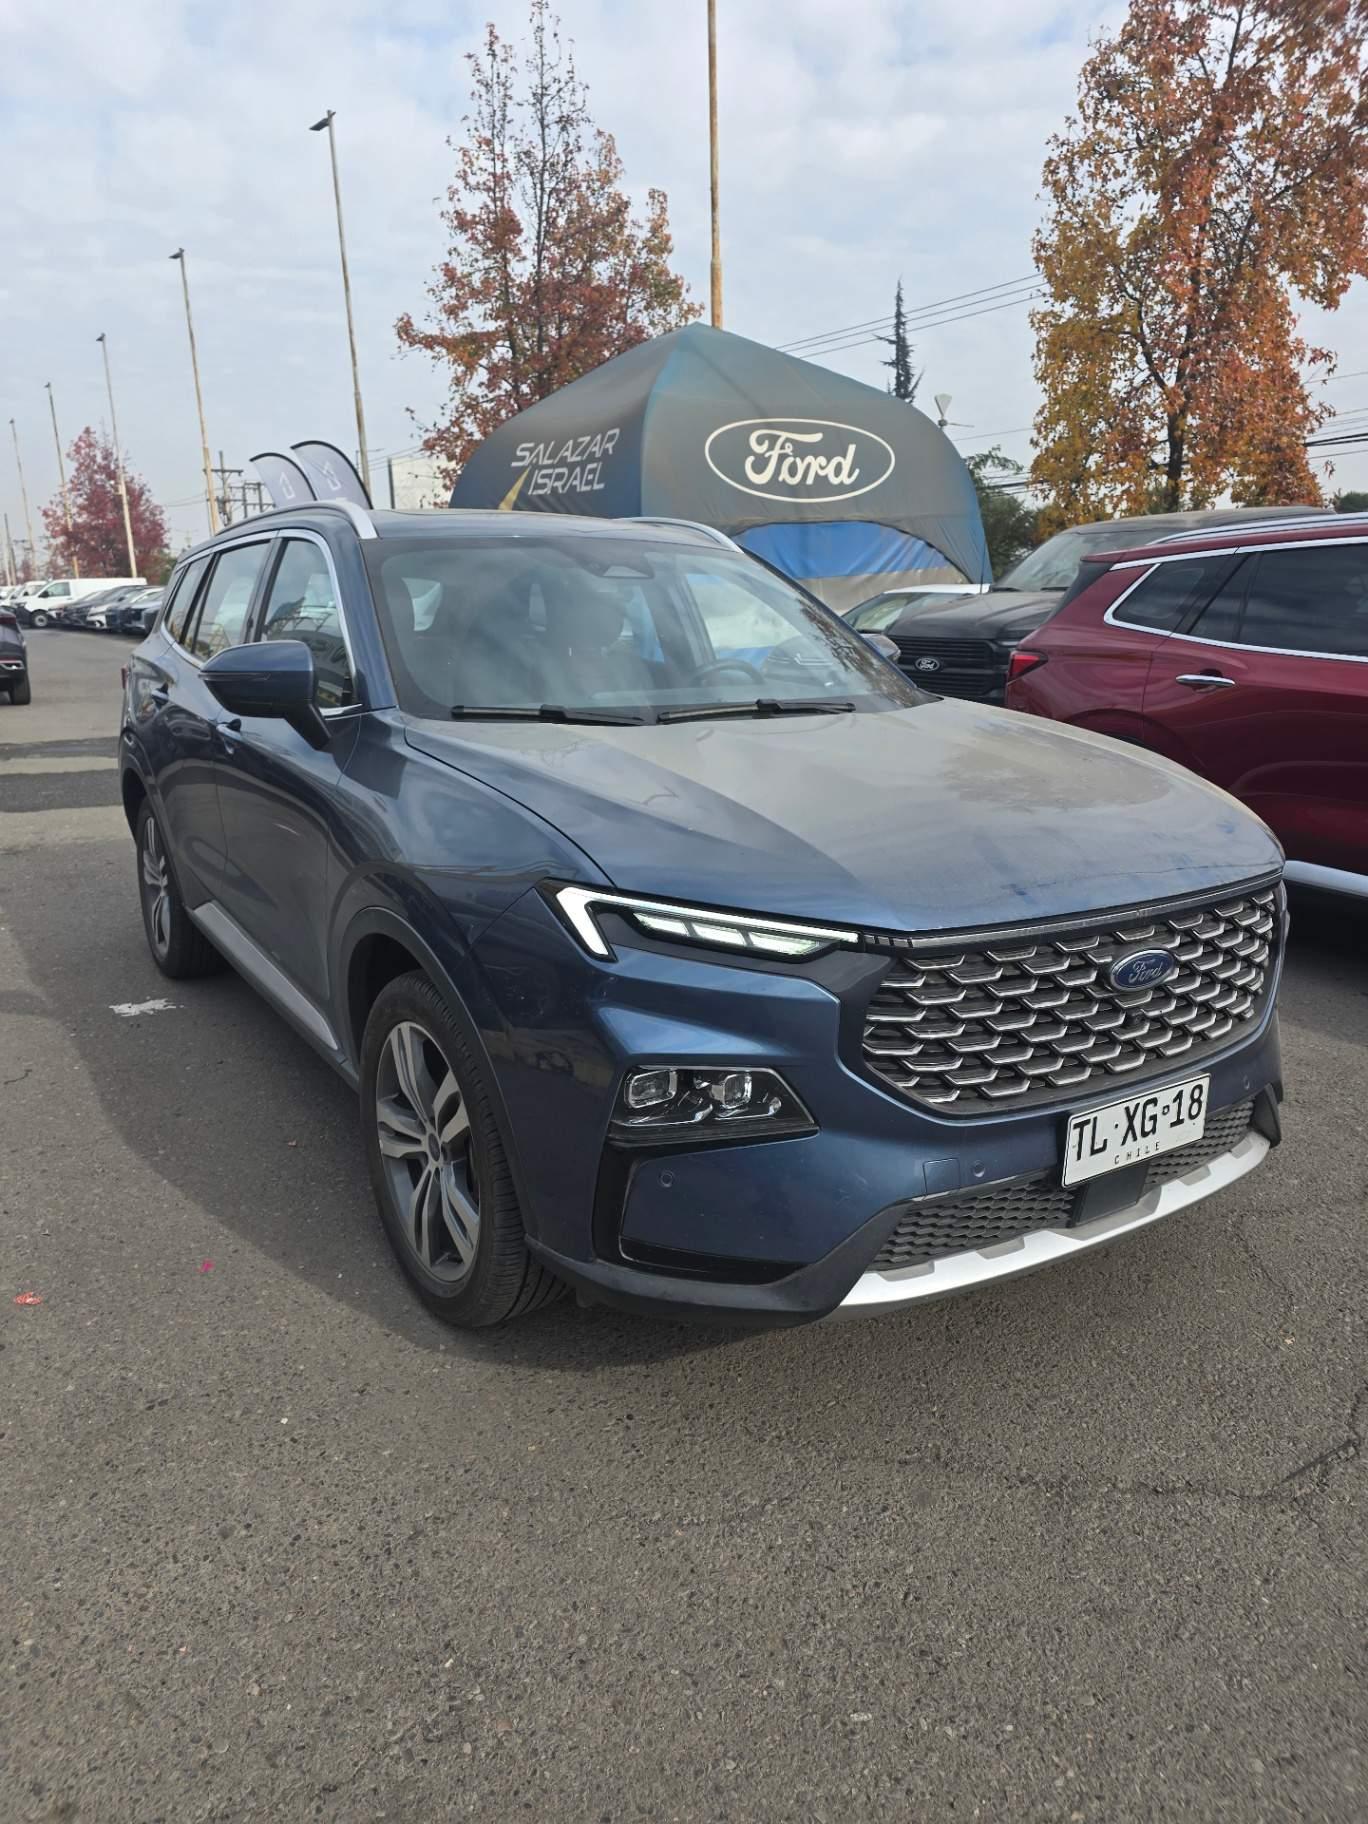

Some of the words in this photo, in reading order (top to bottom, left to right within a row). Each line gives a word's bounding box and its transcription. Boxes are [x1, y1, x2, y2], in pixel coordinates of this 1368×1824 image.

[511, 428, 620, 468] SALAZAR
[745, 430, 859, 486] Ford
[528, 462, 606, 496] ISRAEL
[1128, 959, 1164, 984] Ford
